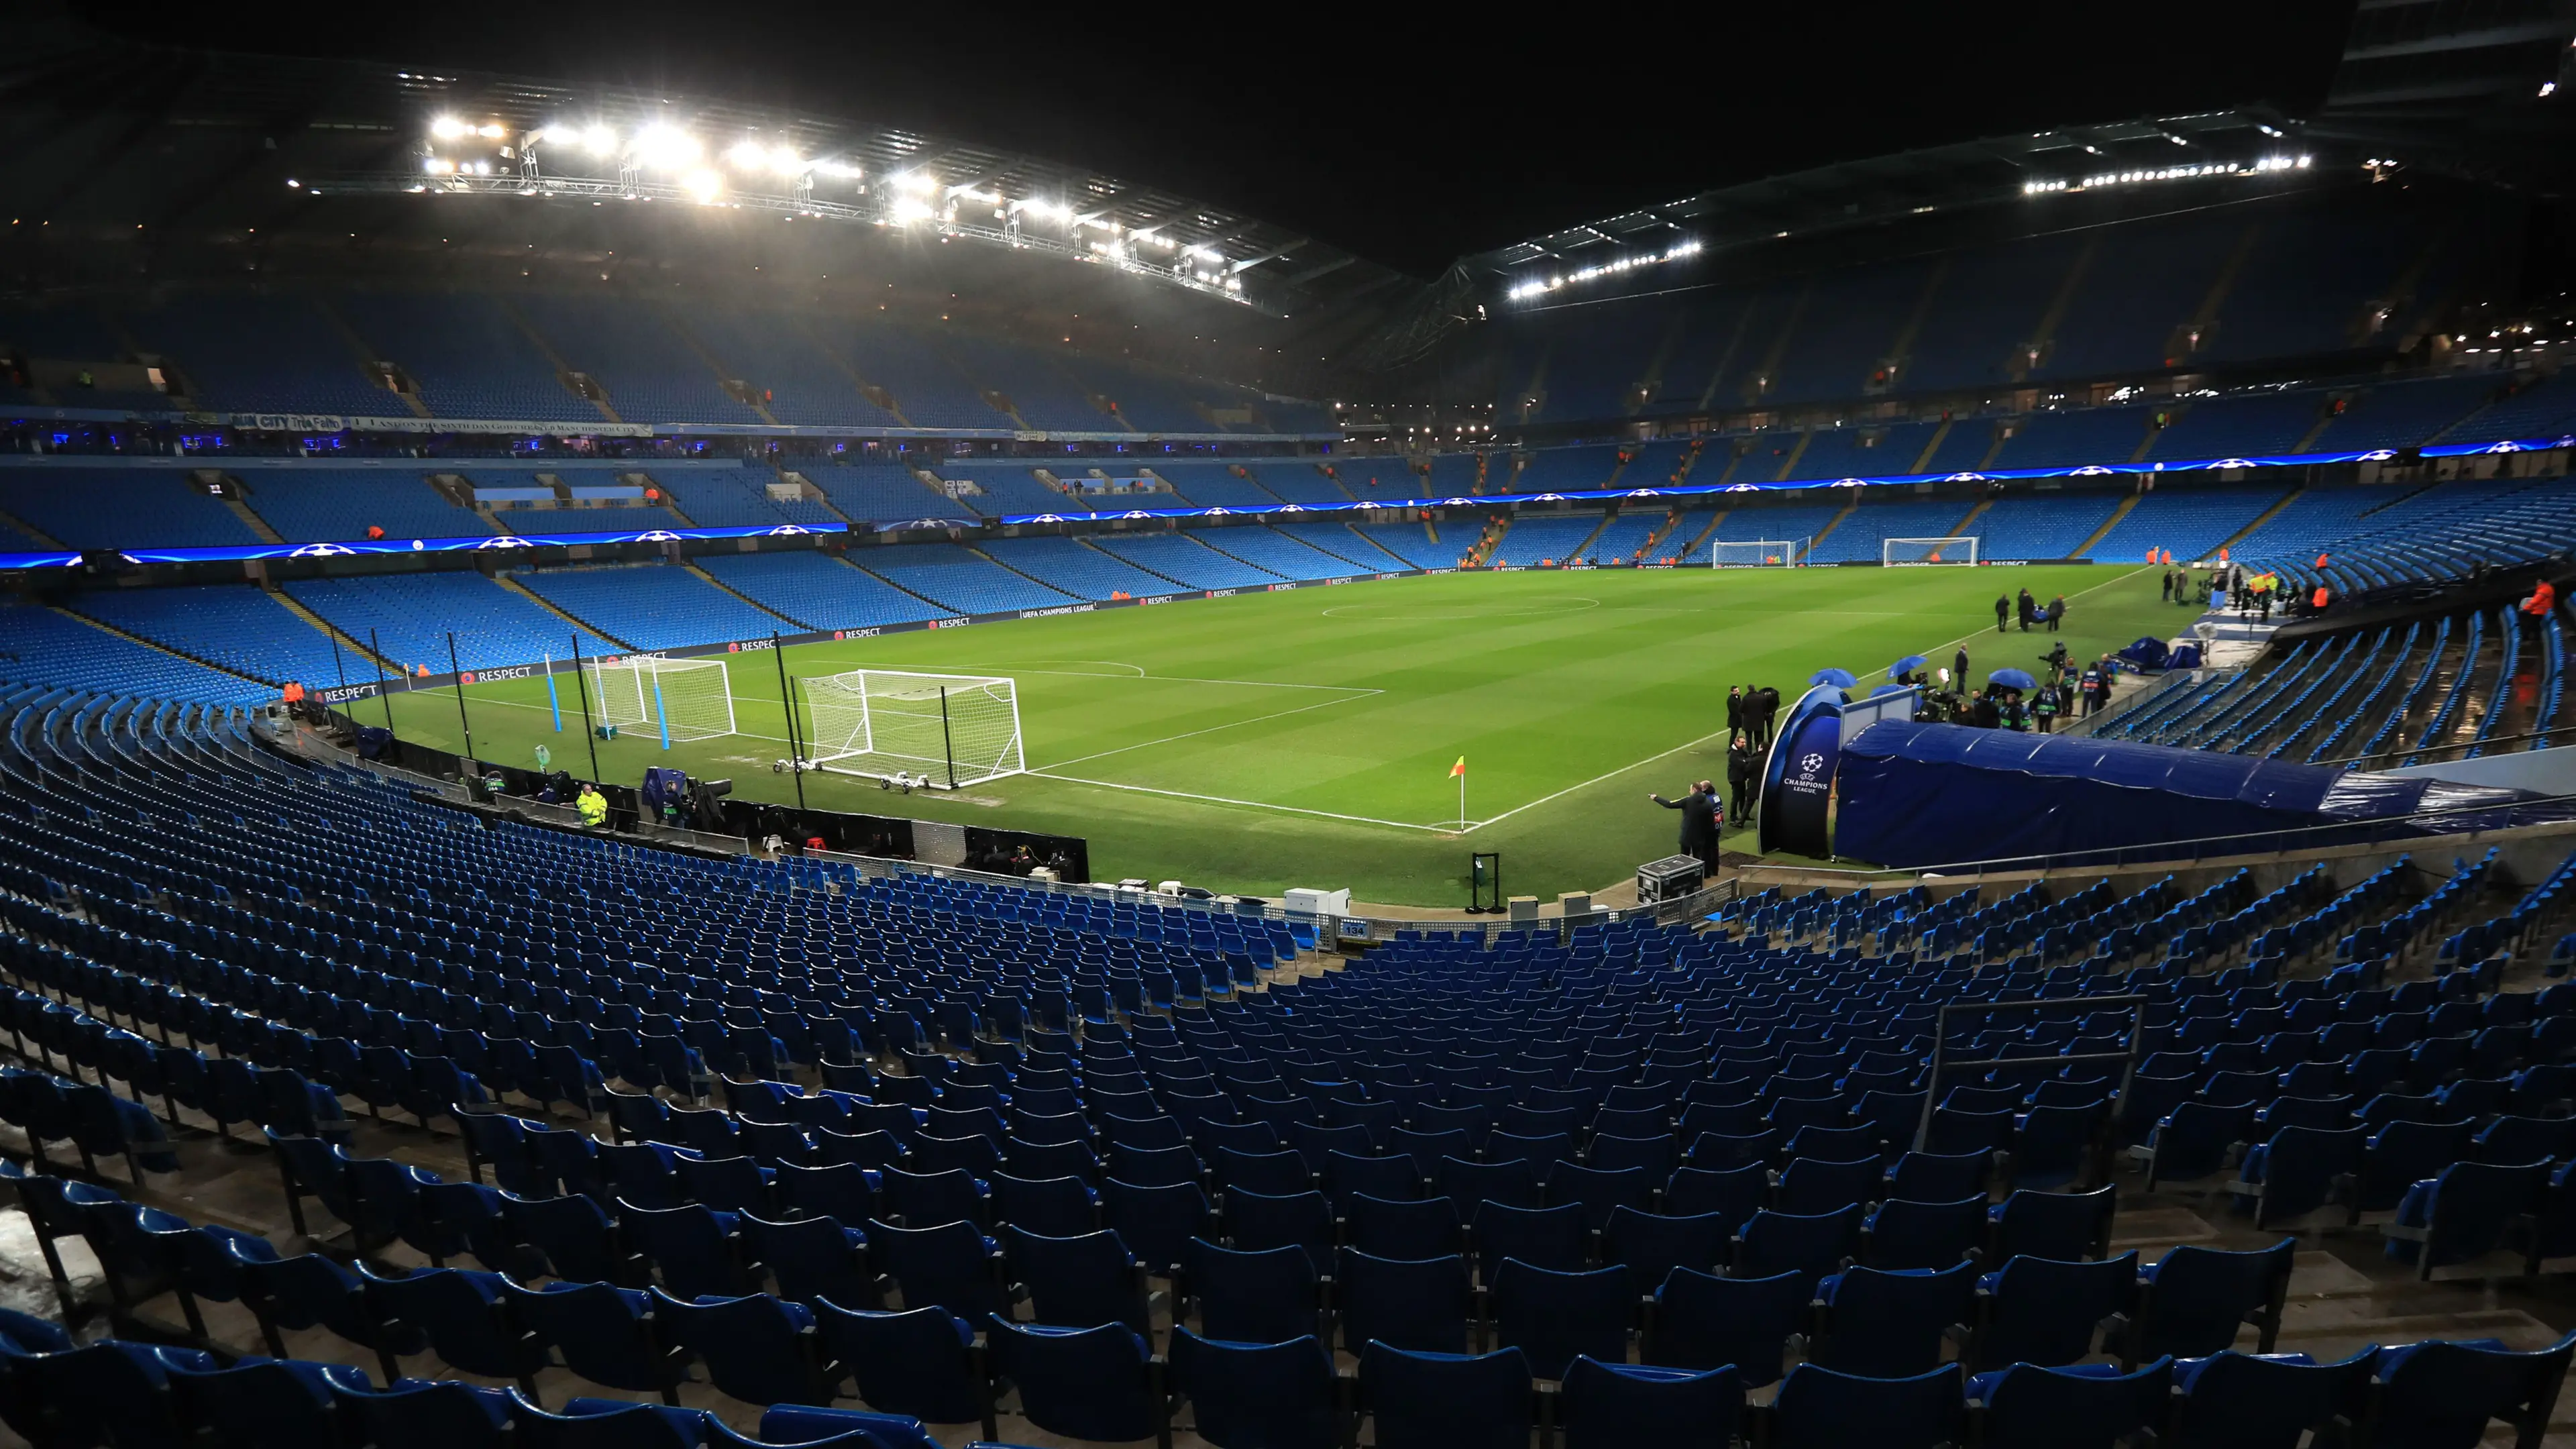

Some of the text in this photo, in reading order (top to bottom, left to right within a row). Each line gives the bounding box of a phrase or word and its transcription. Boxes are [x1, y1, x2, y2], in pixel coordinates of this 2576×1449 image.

[260, 415, 288, 427] CITY
[1275, 583, 1296, 591] RESPECT
[1214, 589, 1236, 598] RESPECT
[1147, 596, 1173, 605] RESPECT
[1022, 604, 1094, 619] UEFA CHAMPIONS LEAGUE
[939, 617, 970, 629] RESPECT
[846, 627, 881, 639] RESPECT
[741, 639, 780, 651] RESPEC
[478, 667, 531, 682] RESPECT
[325, 685, 376, 702] RESPECT
[1799, 773, 1816, 782] UEFA
[1784, 778, 1828, 790] CHAMPIONS
[1793, 786, 1816, 794] LEAGUE
[1346, 926, 1364, 935] 134
